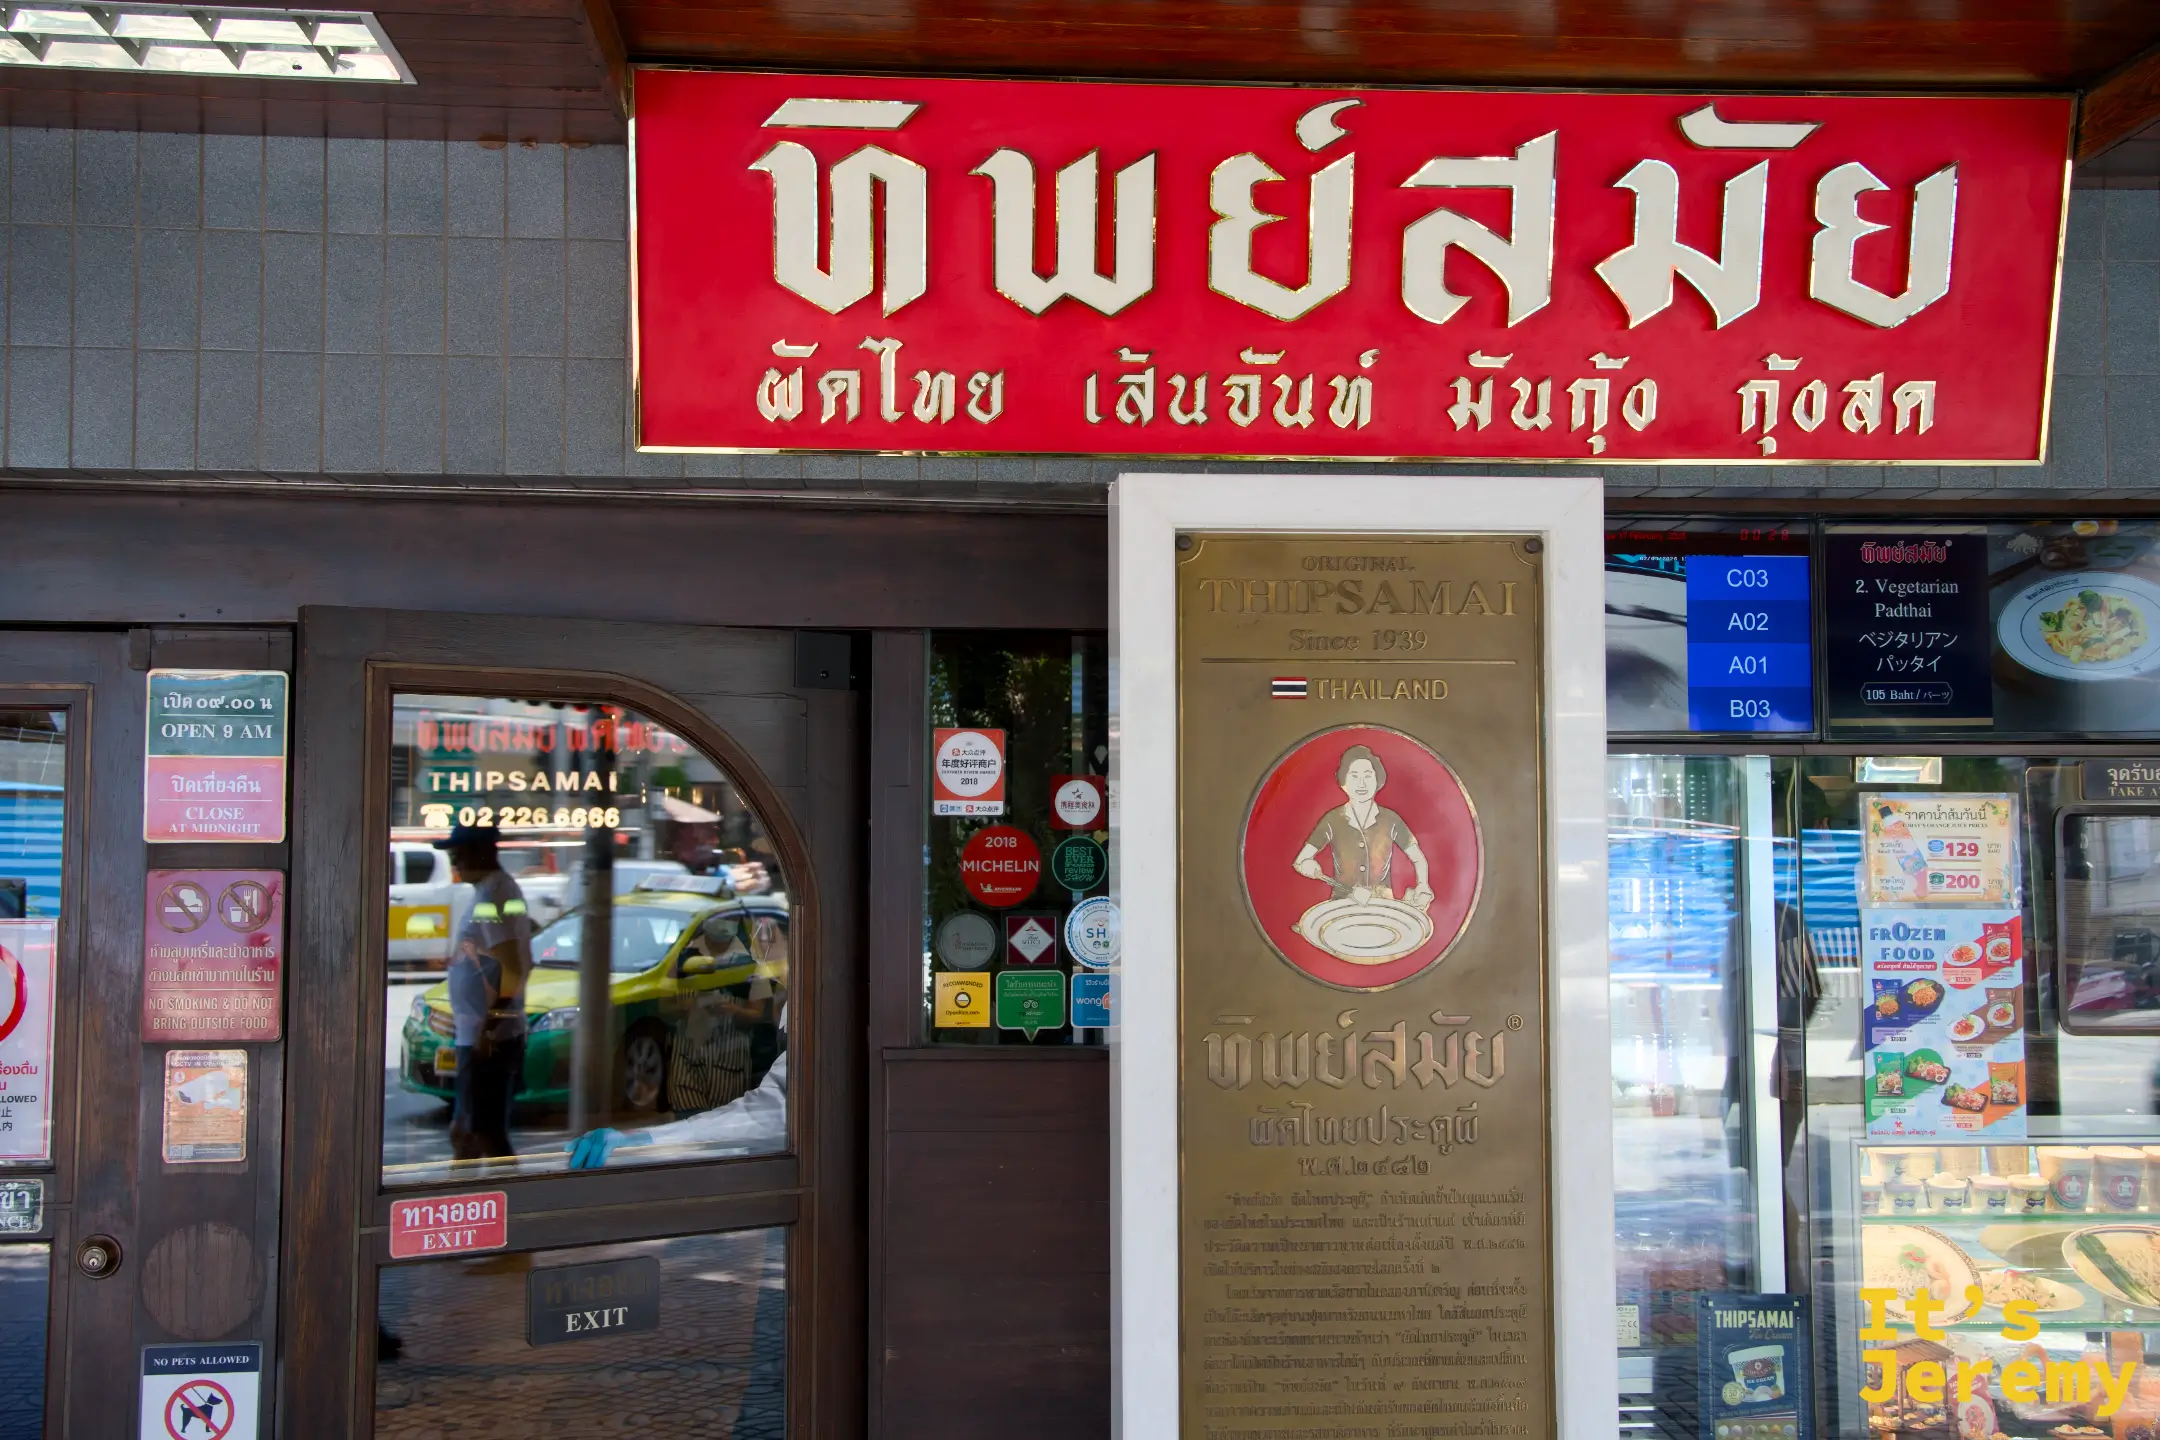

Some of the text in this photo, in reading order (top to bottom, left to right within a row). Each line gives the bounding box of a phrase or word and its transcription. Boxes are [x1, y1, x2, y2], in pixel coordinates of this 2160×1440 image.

[748, 96, 1960, 331] ทิพย์สมัย
[1446, 350, 1659, 455] มันกุ้ง
[1736, 353, 1937, 457] กุ้งสด
[1604, 532, 1616, 540] ue
[1302, 556, 1416, 572] ORIGINAL
[1726, 568, 1769, 588] C03
[1855, 578, 1959, 598] 2. Vegetarian
[1199, 578, 1517, 617] THIPSAMAI
[1874, 602, 1933, 618] Padthai
[1727, 612, 1769, 631] A02
[1288, 629, 1428, 651] Since 1939
[1858, 630, 1959, 649] ベジタリアン
[1728, 656, 1767, 674] A01
[1876, 655, 1942, 673] パッタイ
[1312, 678, 1449, 700] THAILAND
[1865, 689, 1886, 700] 105
[1890, 689, 1914, 700] Baht
[163, 691, 193, 710] เปิด
[259, 697, 273, 710] น
[1729, 699, 1771, 718] B03
[161, 723, 273, 739] OPEN 9 AM
[941, 758, 996, 769] 年度好评商户
[171, 770, 262, 794] ปิดเที่ยงคืน
[428, 770, 618, 792] THIPSAMAI
[960, 777, 979, 786] 2018
[2107, 786, 2160, 797] TAKE A
[185, 806, 245, 821] CLOSE
[458, 806, 621, 829] 02 226 6666
[1904, 803, 1987, 821] ราคาน้ำส้มวันนี้
[168, 823, 261, 834] AT MIDNIGHT
[984, 836, 1018, 848] 2018
[1945, 842, 1979, 857] 129
[1065, 846, 1093, 856] BEST
[962, 859, 1039, 873] MICHELIN
[1064, 855, 1095, 864] EVER
[1945, 874, 1980, 889] 200
[1086, 928, 1110, 939] SH
[1869, 921, 1946, 942] FROZEN
[150, 941, 275, 963] ห้ามสูบบุหรี่และนำอาหาร
[1880, 947, 1935, 961] FOOD
[942, 979, 984, 989] RECOMMENDED
[149, 997, 274, 1011] NO SMOKING & DO NOT
[153, 1016, 268, 1030] BRING OUTSIDE FOOD
[0, 1061, 39, 1076] องดื่ม
[0, 1095, 38, 1103] LOWED
[0, 1106, 13, 1118] 止
[0, 1121, 13, 1132] 内
[1249, 1100, 1479, 1156] ผัดไทยประตูผี
[402, 1199, 497, 1228] ทางออก
[422, 1229, 477, 1250] EXIT
[565, 1306, 629, 1333] EXIT
[1714, 1310, 1794, 1329] THIPSAMAI
[153, 1355, 250, 1366] NO PETS ALLOWED
